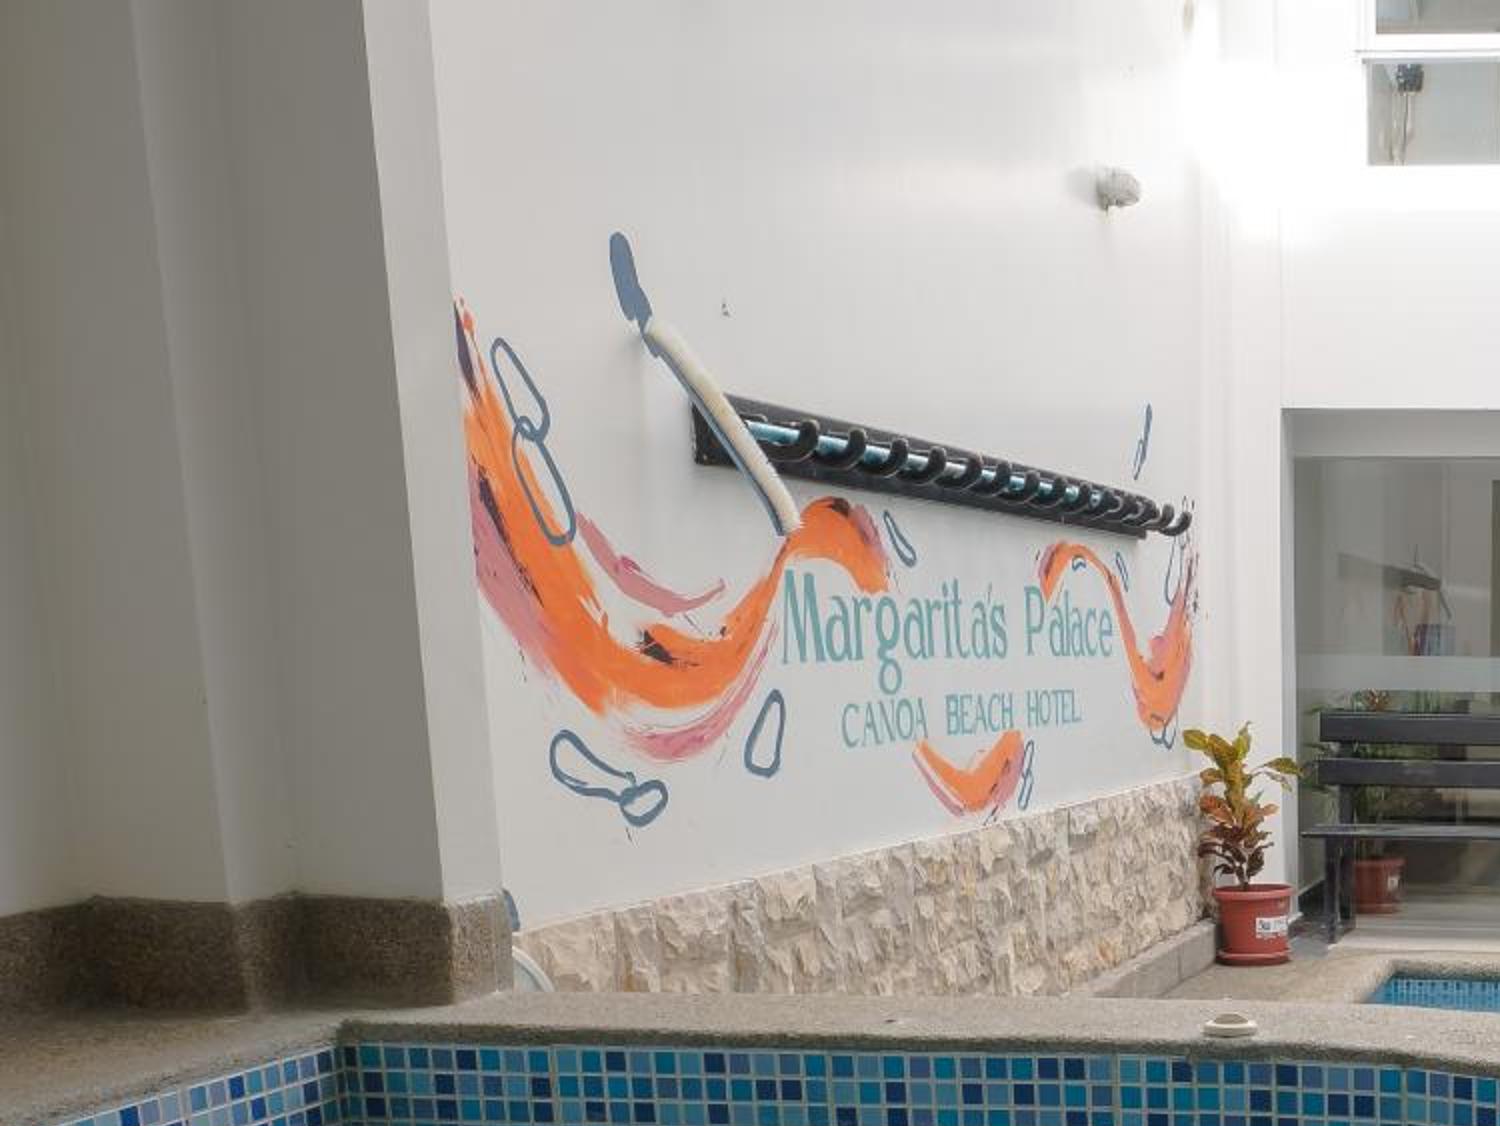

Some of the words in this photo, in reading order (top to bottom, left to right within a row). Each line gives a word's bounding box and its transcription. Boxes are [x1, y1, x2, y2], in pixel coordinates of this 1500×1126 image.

[782, 569, 1008, 695] Margarita's
[1024, 586, 1112, 657] Palace
[841, 697, 928, 747] CANOA
[946, 692, 1014, 735] BEACH
[1027, 689, 1082, 727] HOTEL
